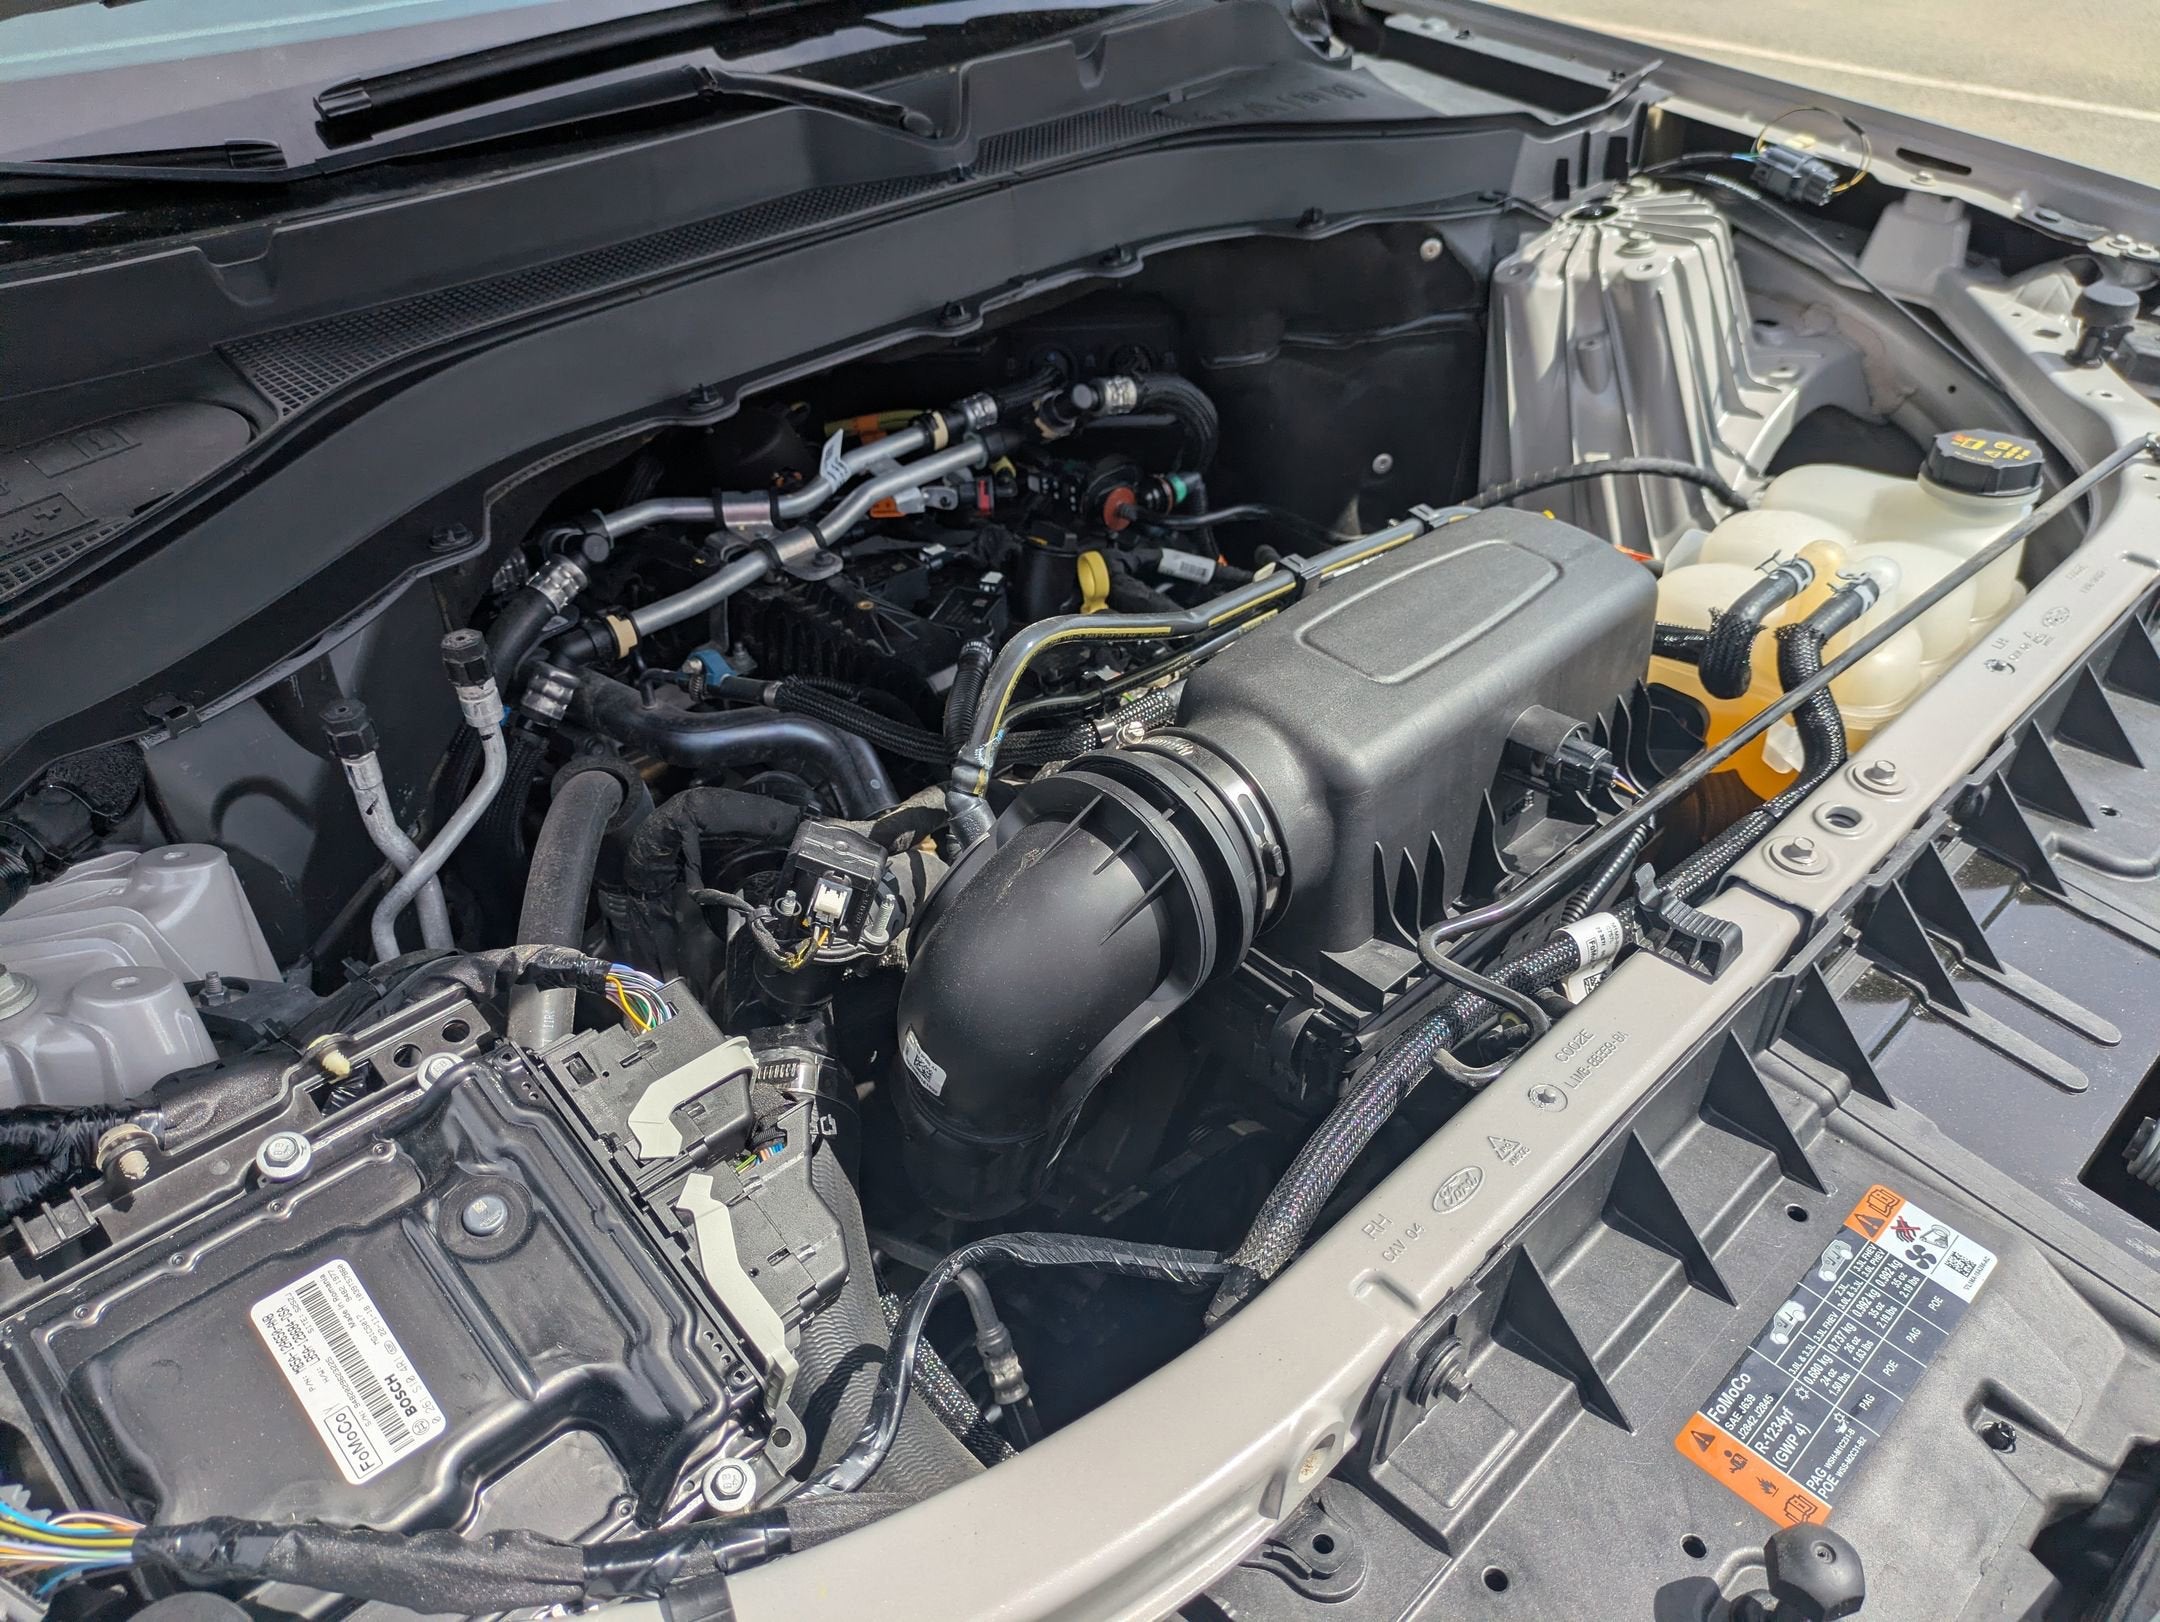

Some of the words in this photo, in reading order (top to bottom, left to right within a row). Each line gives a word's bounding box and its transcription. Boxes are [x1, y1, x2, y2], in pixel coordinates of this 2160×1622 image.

[1437, 1170, 1480, 1210] Ford
[1361, 1213, 1393, 1240] RH
[1382, 1239, 1407, 1264] CAV
[1405, 1221, 1425, 1241] 04
[1853, 1259, 1867, 1271] 3.3L
[1861, 1243, 1876, 1260] FHEV
[1861, 1264, 1875, 1277] 3.0L
[1869, 1248, 1885, 1265] PHEV
[1875, 1266, 1895, 1287] 0.992
[1887, 1259, 1903, 1270] kg
[1890, 1277, 1902, 1288] 35
[1898, 1271, 1907, 1280] oz
[1898, 1283, 1913, 1298] 2.19
[1907, 1275, 1920, 1286] lbs
[319, 1273, 339, 1302] Romania
[1837, 1296, 1851, 1309] 3.0L
[1849, 1279, 1863, 1292] 3.3L
[337, 1301, 344, 1310] in
[1851, 1296, 1872, 1317] 0.992
[1864, 1288, 1881, 1300] kg
[1867, 1307, 1879, 1318] 35
[1875, 1301, 1885, 1311] oz
[1928, 1295, 1943, 1311] POE
[299, 1313, 314, 1333] SITE:
[342, 1309, 355, 1328] Made
[1813, 1328, 1827, 1341] 3.3L
[1822, 1311, 1838, 1329] FHEV
[1876, 1313, 1892, 1329] 2.19
[1884, 1305, 1897, 1317] lbs
[1827, 1329, 1847, 1352] 0.737
[1840, 1322, 1857, 1334] kg
[1843, 1342, 1855, 1353] 26
[1851, 1335, 1861, 1345] oz
[1905, 1327, 1921, 1343] PAG
[1788, 1361, 1803, 1374] 3.0L
[1801, 1343, 1816, 1356] 3.3L
[1852, 1348, 1867, 1363] 1.63
[1860, 1339, 1874, 1351] lbs
[1803, 1362, 1823, 1384] 0.680
[1816, 1353, 1833, 1366] kg
[1819, 1374, 1831, 1386] 24
[1827, 1367, 1837, 1378] oz
[1882, 1359, 1898, 1376] POE
[384, 1373, 417, 1417] BOSCH
[1706, 1372, 1751, 1422] FoMoCo
[1828, 1380, 1843, 1396] 1.50
[1836, 1372, 1850, 1384] lbs
[1724, 1410, 1742, 1430] SAE
[1738, 1393, 1756, 1413] J639
[1858, 1393, 1875, 1410] PAG
[1737, 1415, 1758, 1439] J2842
[1753, 1393, 1773, 1417] J2845
[1754, 1405, 1794, 1454] R-1234yf
[335, 1412, 374, 1471] FoMoCo
[1772, 1433, 1798, 1468] (GWP
[1794, 1422, 1811, 1436] 4)
[1805, 1466, 1827, 1490] PAG
[1817, 1473, 1839, 1499] POE
